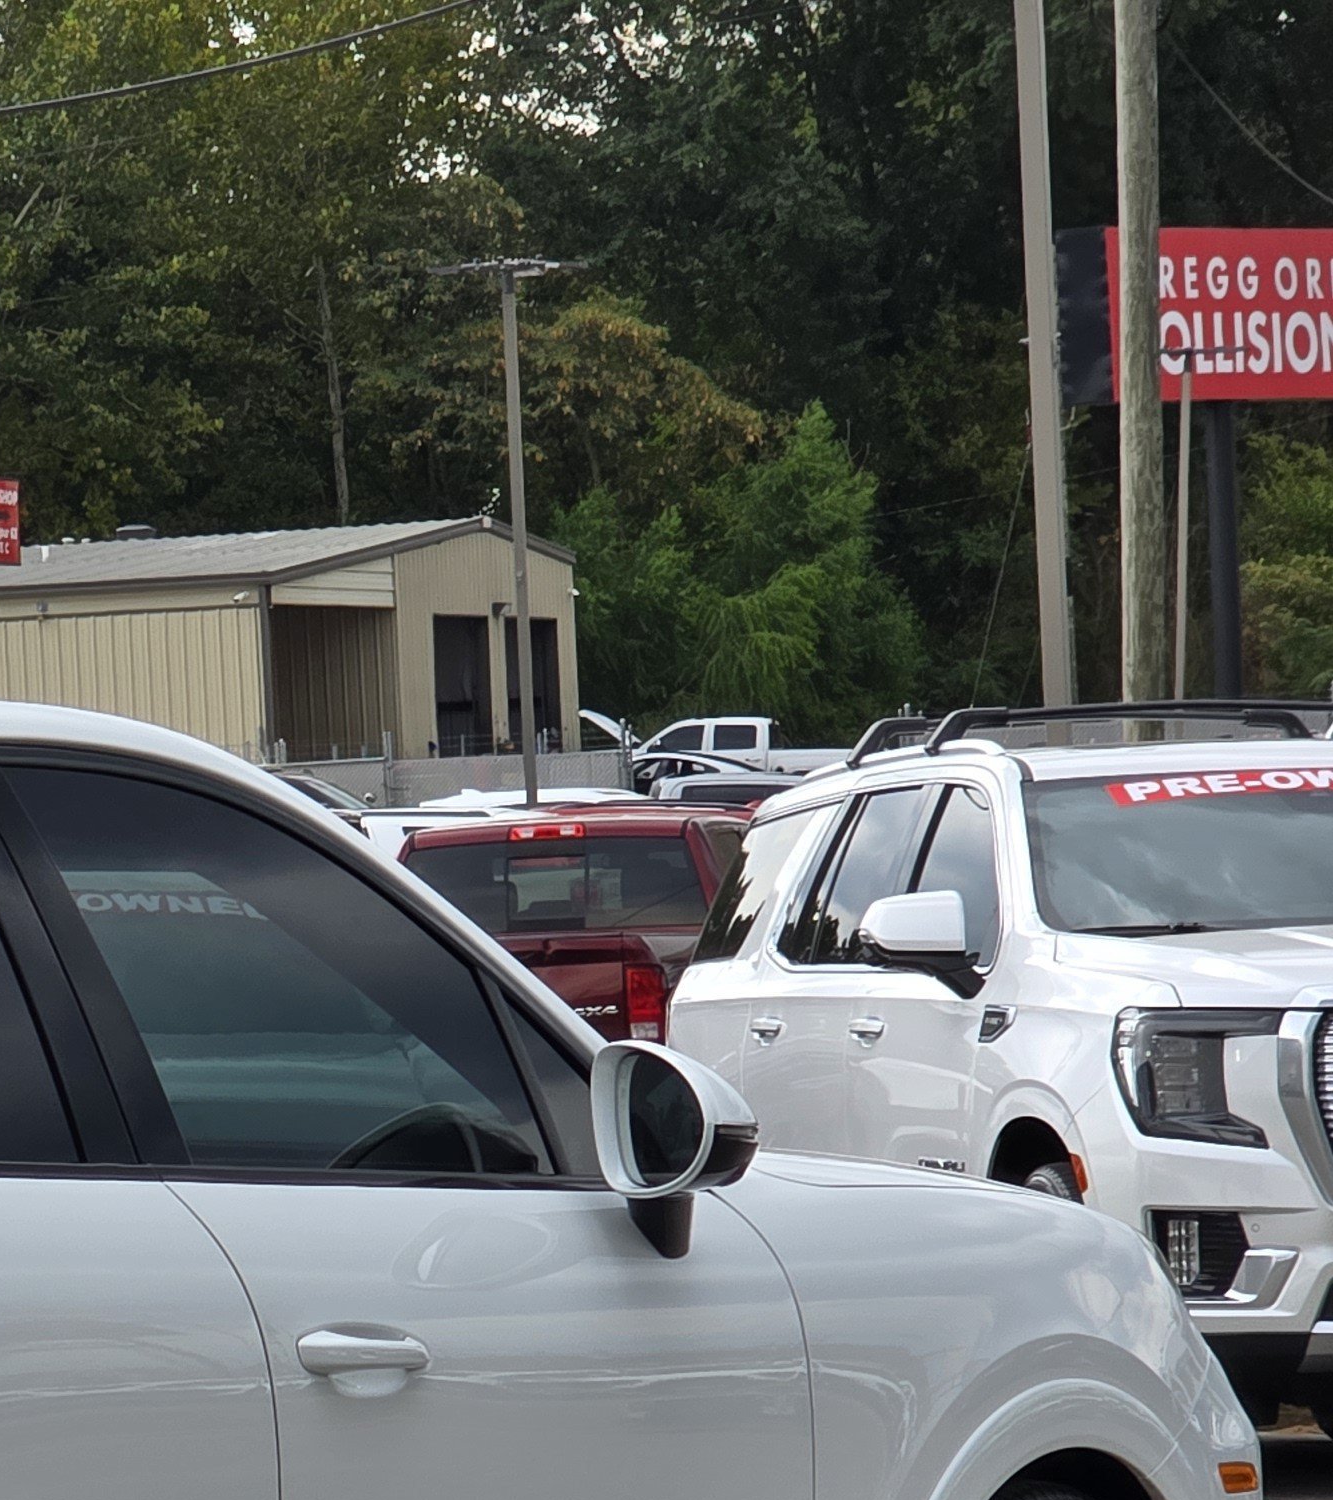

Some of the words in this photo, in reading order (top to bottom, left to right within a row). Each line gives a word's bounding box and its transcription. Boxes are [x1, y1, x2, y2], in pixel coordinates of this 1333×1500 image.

[1159, 256, 1259, 299] REGG
[1274, 257, 1333, 300] OR
[1159, 311, 1333, 375] OLLISIO
